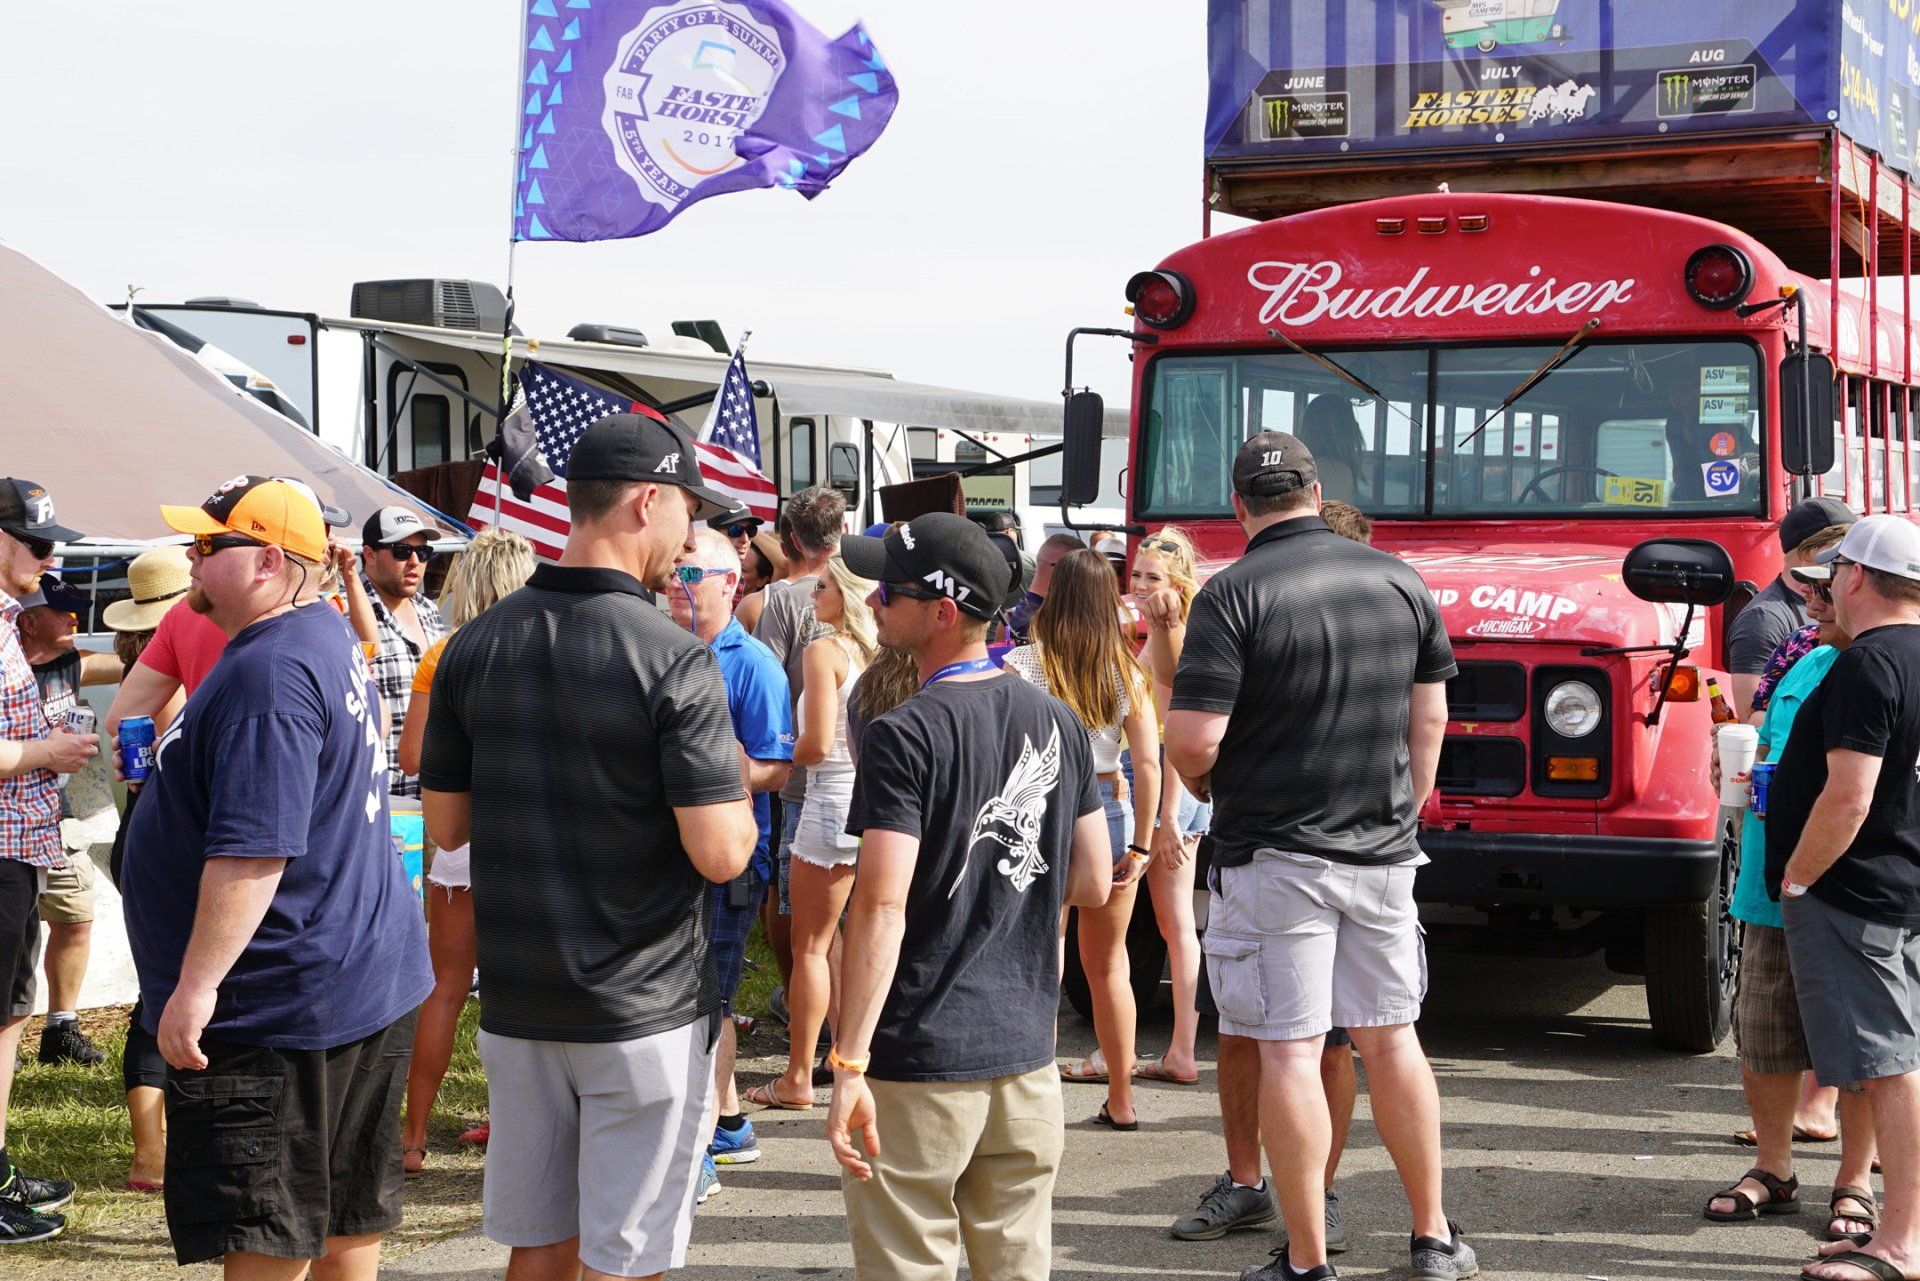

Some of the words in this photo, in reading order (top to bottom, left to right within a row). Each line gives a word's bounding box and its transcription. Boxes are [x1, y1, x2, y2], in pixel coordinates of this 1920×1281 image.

[635, 17, 681, 62] PARTY
[685, 12, 707, 26] OF
[1689, 49, 1725, 63] AUG
[1481, 66, 1522, 80] JULY
[1284, 76, 1325, 90] JUNE
[1692, 75, 1750, 88] MONSTER
[616, 86, 633, 99] FAB
[665, 85, 760, 112] FASTE
[1410, 87, 1537, 110] FASTER
[1292, 102, 1344, 113] MONSTER
[1402, 105, 1530, 128] HORSES
[683, 130, 736, 149] 2017
[625, 130, 643, 156] 5TH
[641, 157, 677, 195] YEAR
[1247, 261, 1635, 326] Budweiser
[1705, 369, 1725, 380] ASV
[1704, 400, 1724, 410] ASV
[1261, 451, 1283, 467] 10
[1711, 472, 1735, 486] SV
[1634, 481, 1653, 503] SV
[1470, 585, 1578, 621] CAMP
[1476, 619, 1534, 634] MICHIGAN
[138, 746, 155, 758] BU
[133, 756, 156, 768] LIG
